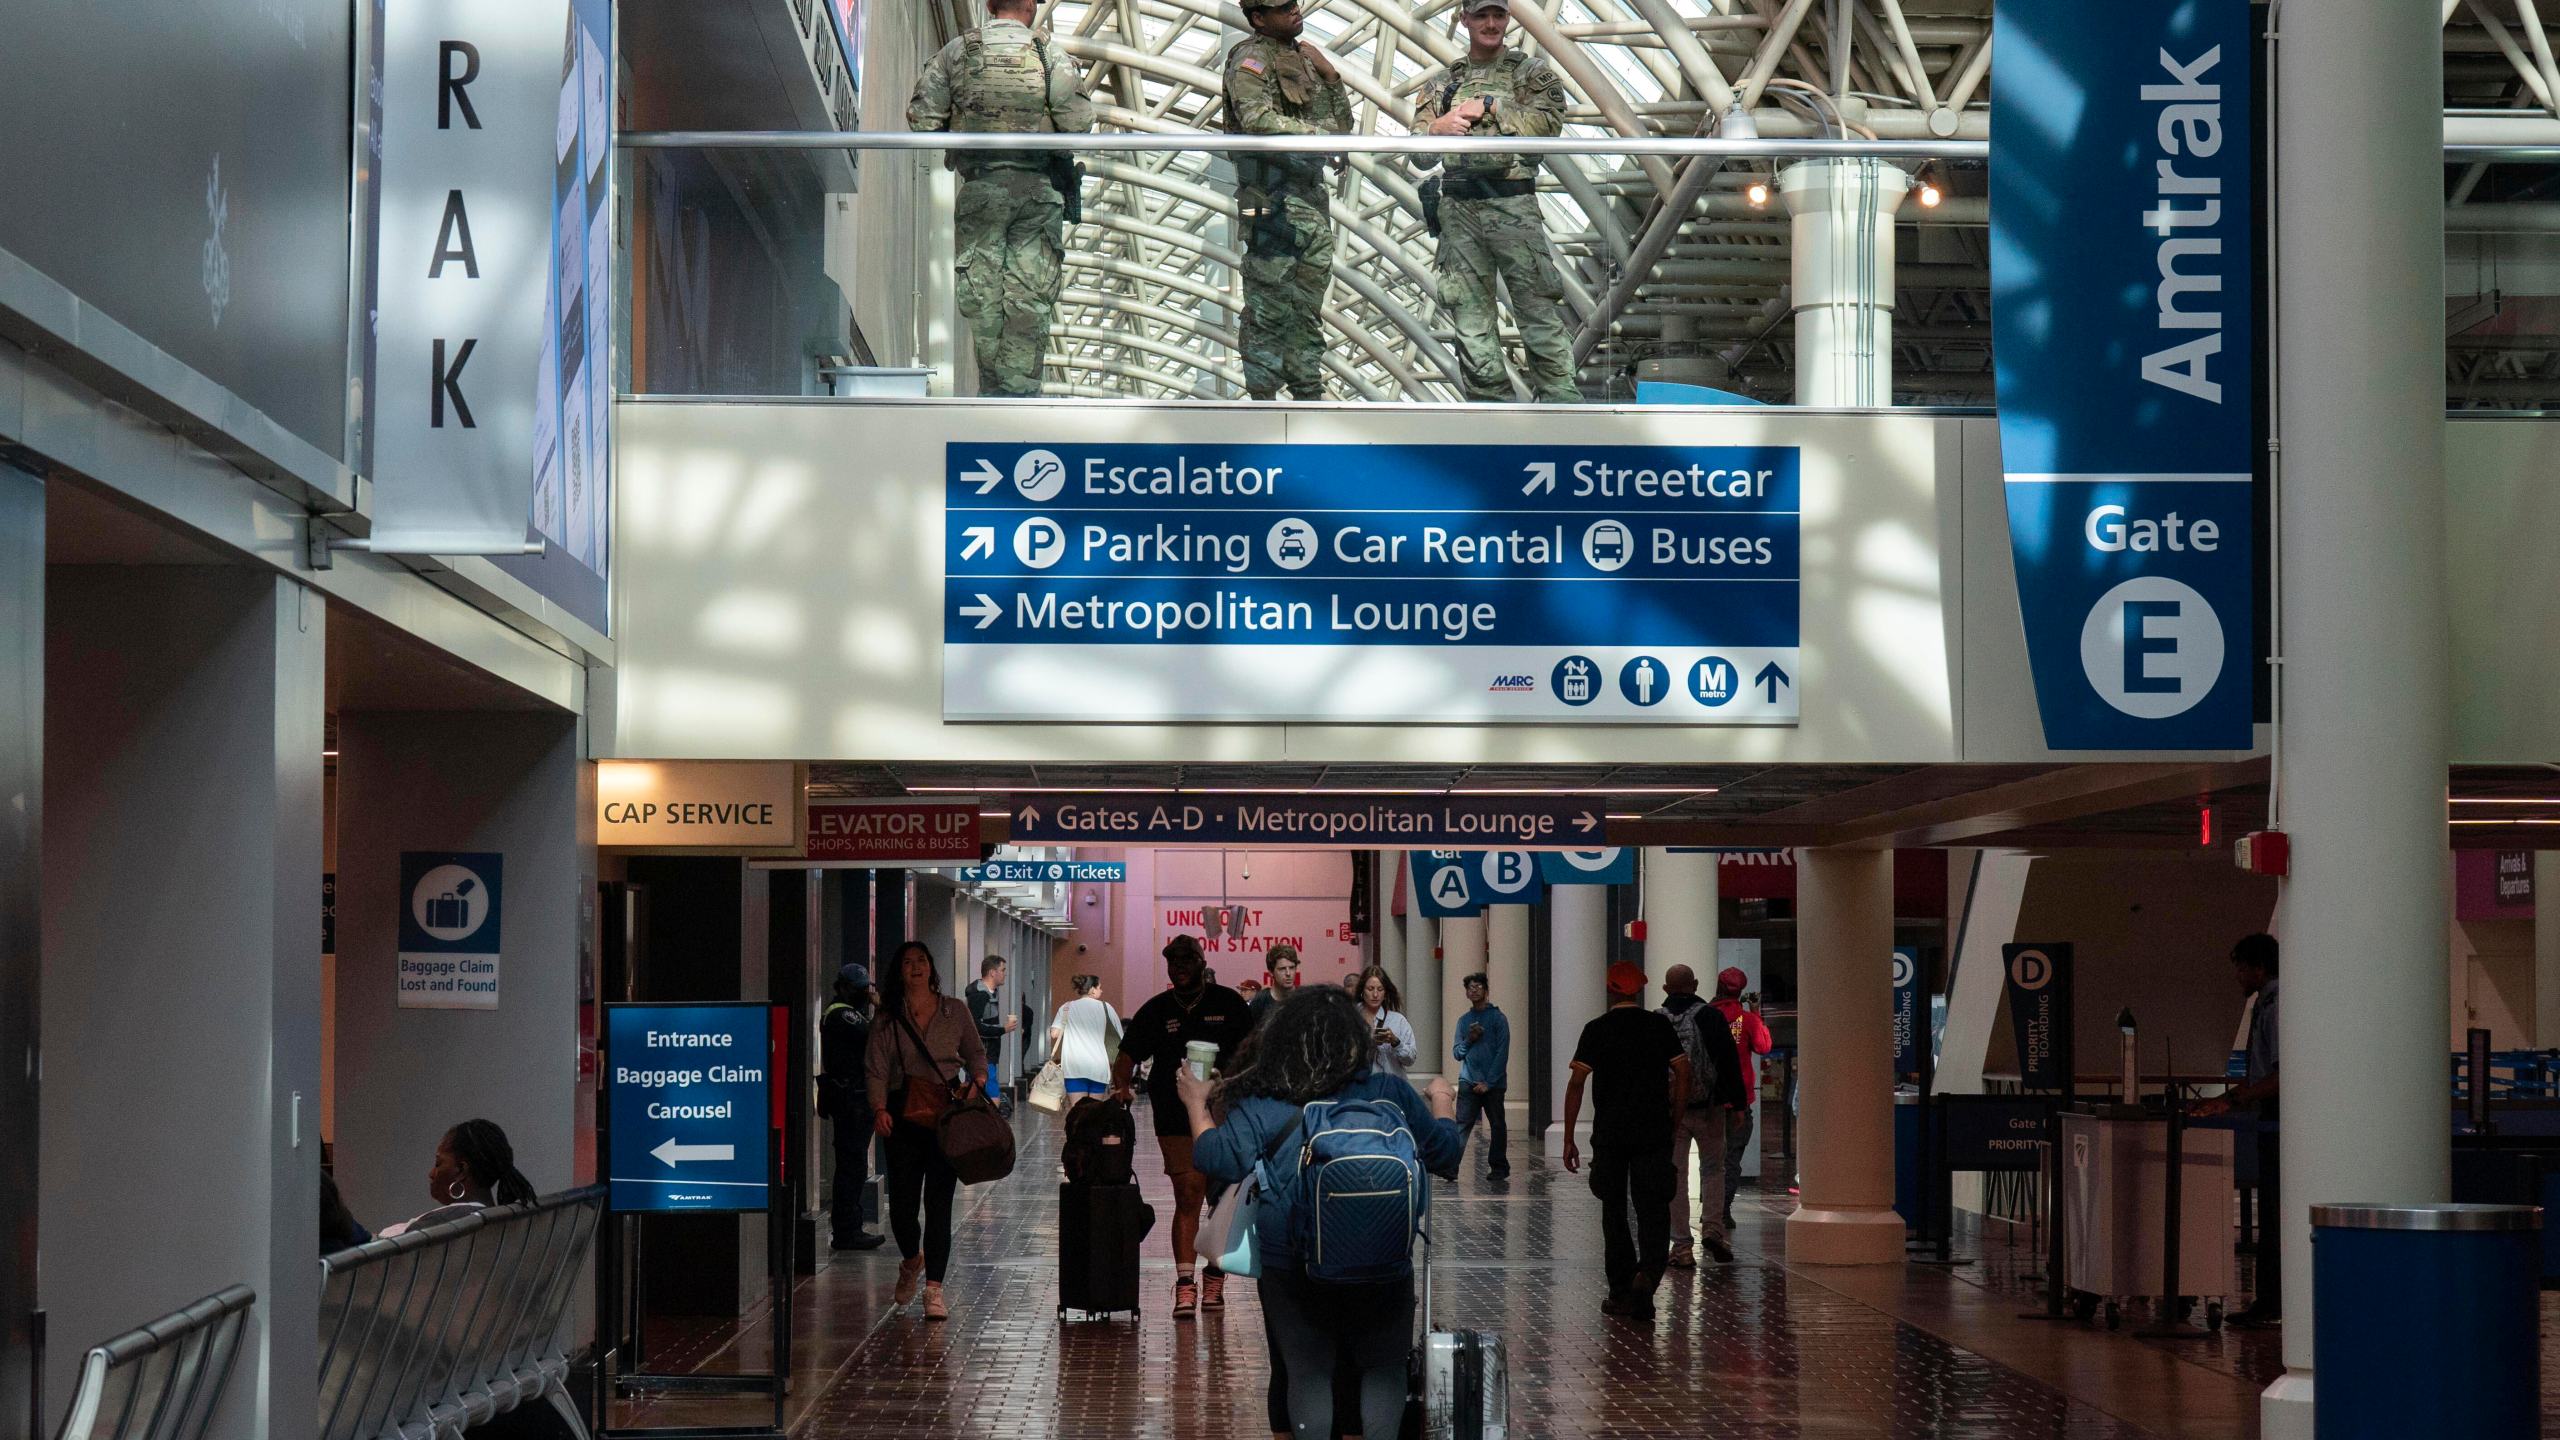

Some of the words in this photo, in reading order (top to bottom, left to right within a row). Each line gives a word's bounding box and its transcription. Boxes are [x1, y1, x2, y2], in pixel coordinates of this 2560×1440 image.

[1539, 72, 1553, 84] MP
[2141, 43, 2222, 405] Amtrak
[1084, 456, 1282, 495] Escalator
[1573, 460, 1772, 497] Streetcar
[2084, 505, 2221, 552] Gate
[1029, 525, 1055, 560] P
[1084, 523, 1250, 572] Parking
[1334, 526, 1406, 564] Car
[1423, 525, 1563, 564] Rental
[1652, 528, 1772, 565] Buses
[1017, 591, 1312, 639] Metropolitan
[1332, 594, 1496, 640] Lounge
[2122, 601, 2182, 694] E
[1492, 675, 1534, 686] MARC
[1700, 664, 1726, 689] M
[1700, 690, 1726, 698] metro
[605, 802, 656, 824] CAP
[667, 803, 773, 825] SERVICE
[936, 813, 969, 834] UP
[1057, 805, 1139, 832] Gates
[1148, 807, 1203, 829] A-D
[1238, 806, 1433, 837] Metropolitan
[1446, 808, 1554, 839] Lounge
[859, 837, 912, 849] PARKING
[917, 838, 925, 849] &
[930, 837, 968, 849] BUSES
[1432, 850, 1462, 859] Gat
[1005, 864, 1032, 879] Exit
[1068, 864, 1120, 879] Tickets
[1498, 851, 1521, 884] B
[1438, 870, 1466, 897] A
[2500, 876, 2529, 899] Departures
[1167, 911, 1229, 926] UNIQO
[401, 960, 455, 975] Baggage
[459, 960, 494, 973] Claim
[2022, 957, 2044, 983] D
[401, 978, 426, 991] Lost
[430, 978, 453, 991] and
[457, 978, 496, 992] Found
[1902, 991, 1911, 1046] BOARDING
[2039, 995, 2049, 1058] BOARDING
[647, 1031, 732, 1048] Entrance
[1894, 1011, 1902, 1058] GENERAL
[2028, 1019, 2038, 1072] PRIORITY
[616, 1066, 701, 1088] Baggage
[708, 1065, 762, 1082] Claim
[647, 1101, 731, 1119] Carousel
[2009, 1118, 2037, 1130] Gate
[1988, 1140, 2041, 1151] PRIORITY
